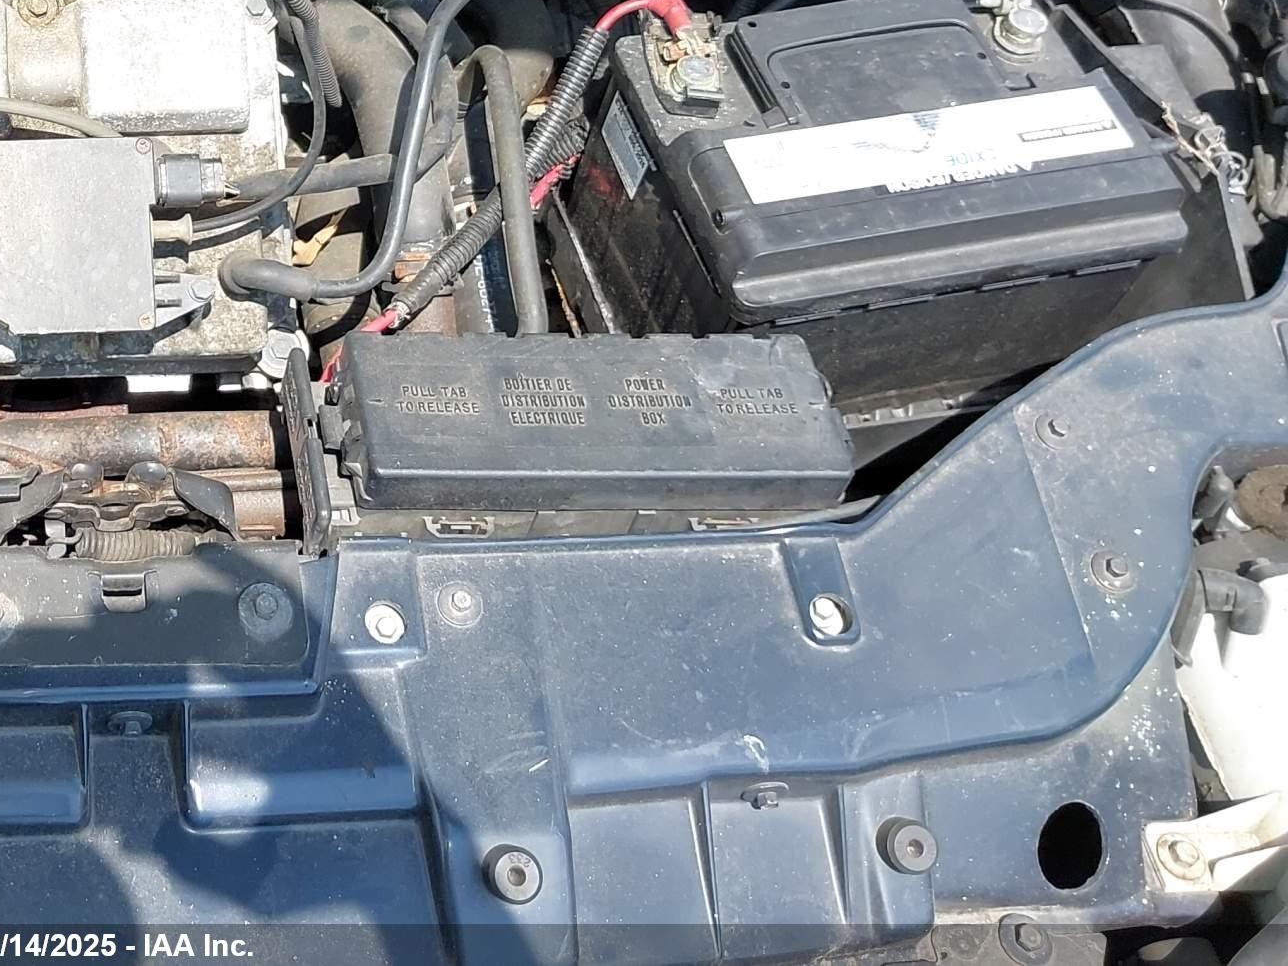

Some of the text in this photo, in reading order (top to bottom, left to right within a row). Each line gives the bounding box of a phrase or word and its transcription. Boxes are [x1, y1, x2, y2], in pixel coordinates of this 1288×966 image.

[557, 378, 572, 391] DE
[624, 378, 665, 391] POWER
[402, 385, 467, 398] PULL TAB
[720, 388, 783, 400] PULL TAB
[397, 401, 480, 413] TO RELEASE
[501, 394, 586, 408] DISTRIBUTION
[608, 394, 692, 408] DISTRIBUTION
[717, 403, 799, 415] TO RELEASE
[511, 411, 585, 425] ELECTRIQUE
[642, 412, 666, 425] BOX
